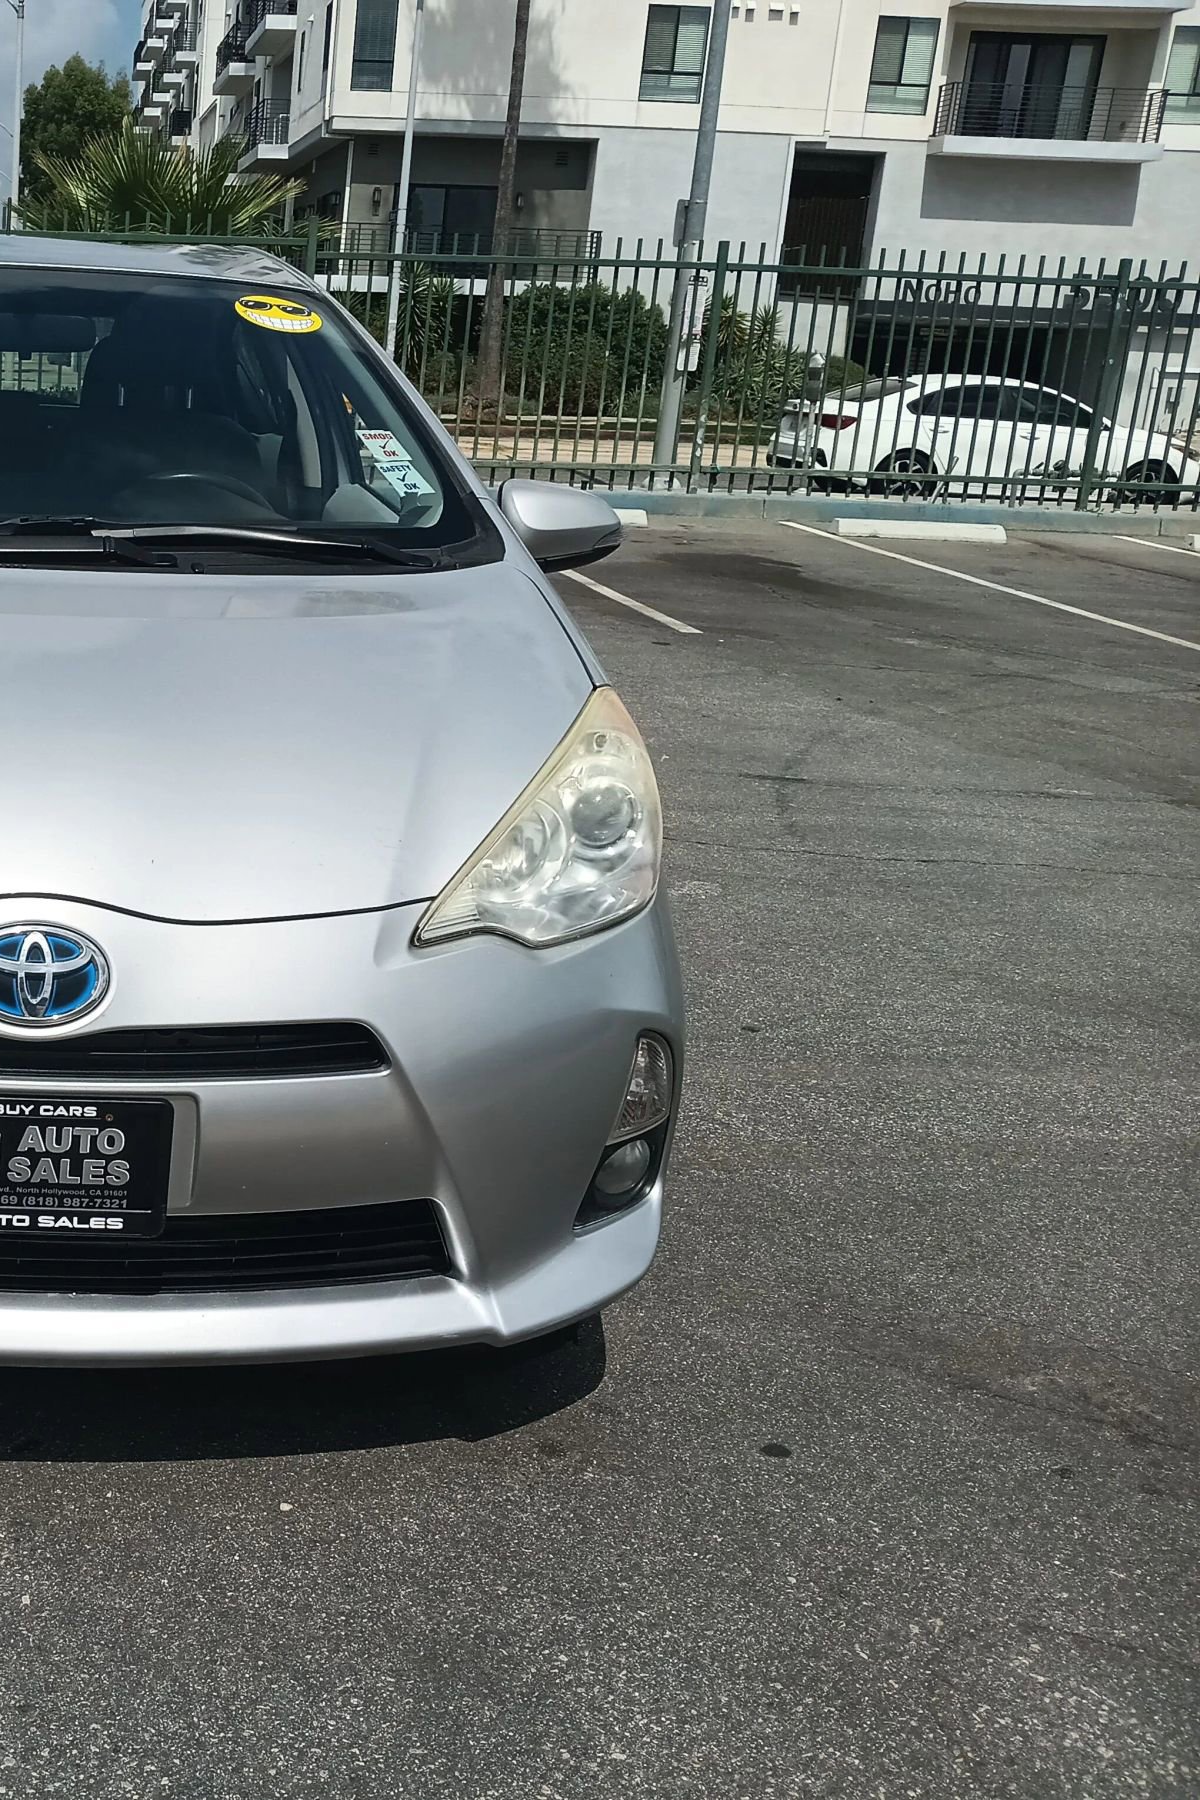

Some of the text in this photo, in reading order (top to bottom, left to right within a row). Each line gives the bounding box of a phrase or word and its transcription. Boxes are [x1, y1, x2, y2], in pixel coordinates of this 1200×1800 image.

[380, 465, 411, 473] SAFETY
[403, 482, 420, 490] OK
[39, 1105, 98, 1117] CARS
[17, 1125, 125, 1155] AUTO
[7, 1156, 130, 1186] SALES
[16, 1186, 40, 1194] North
[22, 1195, 58, 1207] (818)
[63, 1197, 128, 1208] 987-7321
[37, 1214, 124, 1230] SALES
